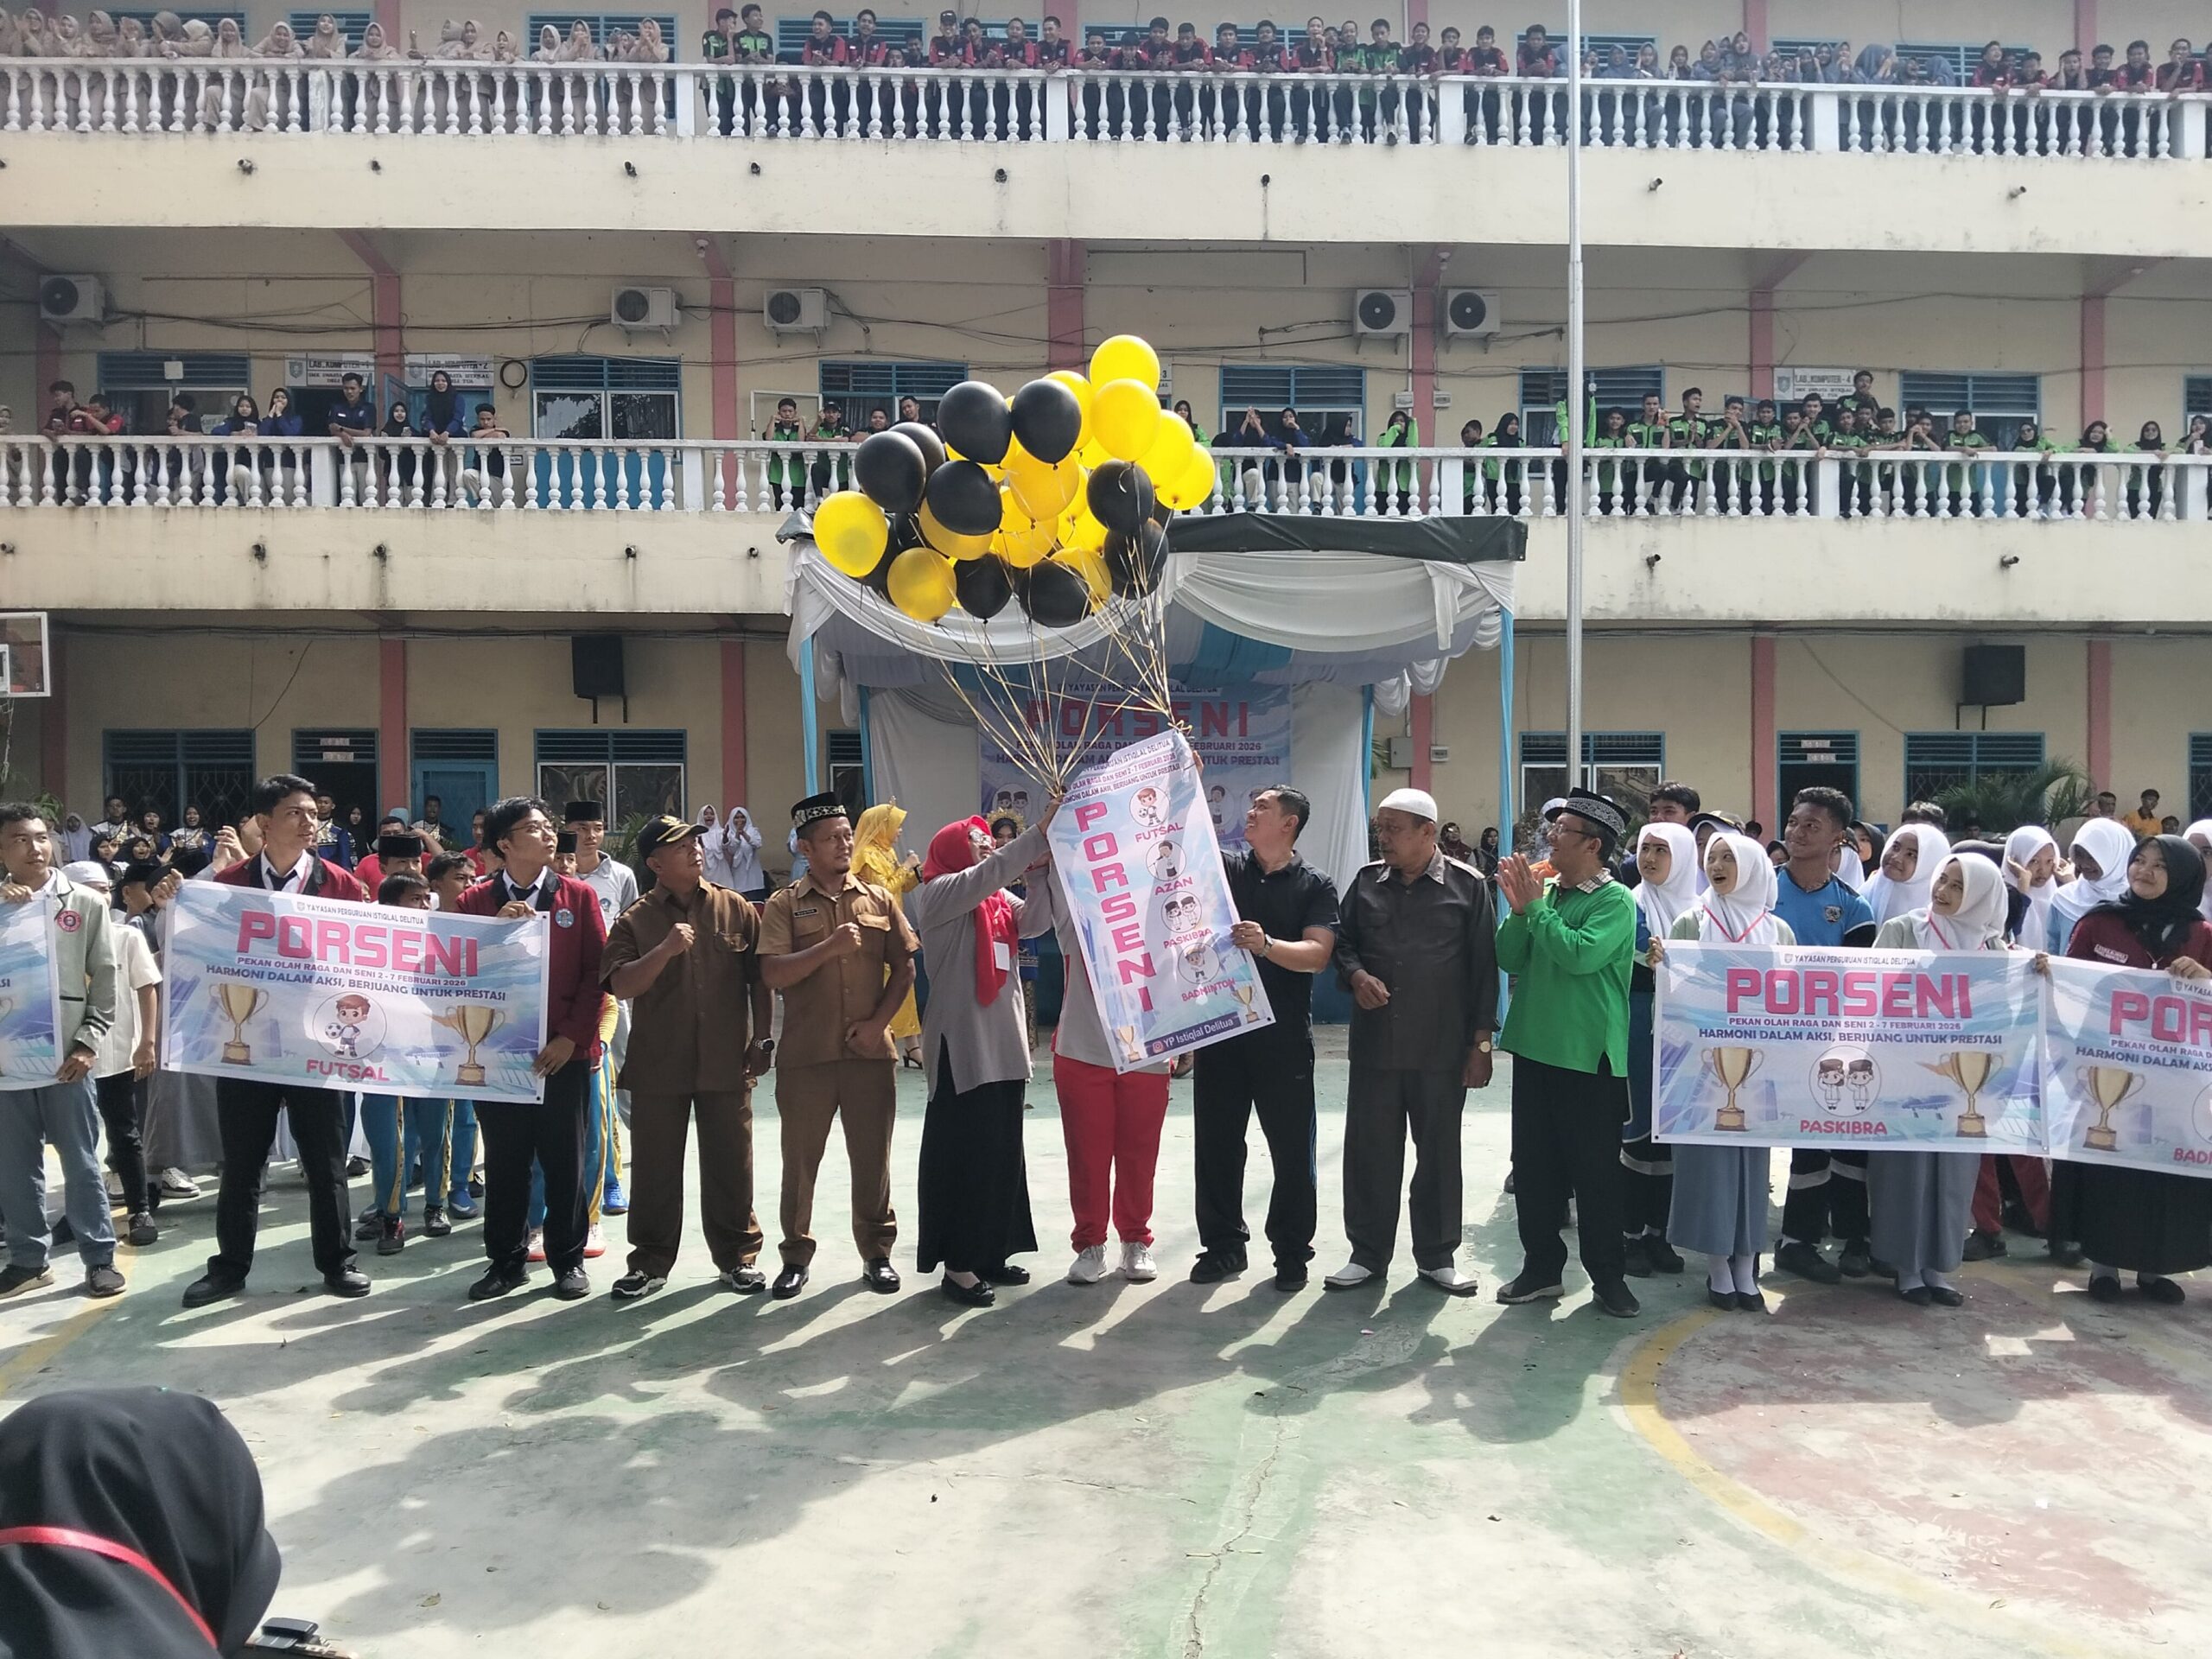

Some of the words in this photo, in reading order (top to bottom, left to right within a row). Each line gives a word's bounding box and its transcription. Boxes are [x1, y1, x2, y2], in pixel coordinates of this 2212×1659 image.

[1135, 823, 1184, 842] FUTSAL
[1154, 876, 1193, 896] AZAN
[307, 904, 337, 913] YAYASAN
[337, 907, 372, 918] PERGURUAN
[400, 916, 423, 925] DELITUA
[237, 910, 478, 977] PORSENI
[1163, 927, 1213, 949] PASKIBRA
[1795, 954, 1826, 963] YAYASAN
[1827, 955, 1861, 963] PERGURUAN
[206, 964, 264, 979] HARMONI
[268, 971, 313, 984] DALAM
[315, 976, 346, 988] AKSI,
[348, 980, 408, 994] BERJUANG
[411, 987, 453, 997] UNTUK
[455, 989, 506, 1001] PRESTASI
[238, 957, 271, 967] PEKAN
[276, 961, 301, 970] OLAH
[303, 963, 330, 973] RAGA
[333, 966, 352, 975] DAN
[355, 969, 376, 978] SENI
[397, 976, 441, 986] FEBRUARI
[1181, 978, 1236, 1001] BADMINTON
[1726, 969, 1973, 1019] PORSENI
[1163, 1036, 1175, 1048] YP
[1176, 1025, 1205, 1044] Istiqlal
[1205, 1018, 1234, 1034] Delitua
[1699, 1028, 1756, 1039] HARMONI
[1759, 1030, 1803, 1040] DALAM
[1807, 1032, 1835, 1042] AKSI,
[1839, 1033, 1902, 1044] BERJUANG
[1905, 1033, 1947, 1043] UNTUK
[1949, 1034, 2002, 1044] PRESTASI
[2075, 1046, 2139, 1063] HARMONI
[2143, 1055, 2190, 1070] DALAM
[2111, 1039, 2145, 1050] PEKAN
[2149, 1044, 2177, 1054] OLAH
[2180, 1047, 2203, 1058] RAGA
[306, 1058, 391, 1081] FUTSAL
[1800, 1120, 1887, 1135] PASKIBRA
[2173, 1147, 2212, 1165] BAD
